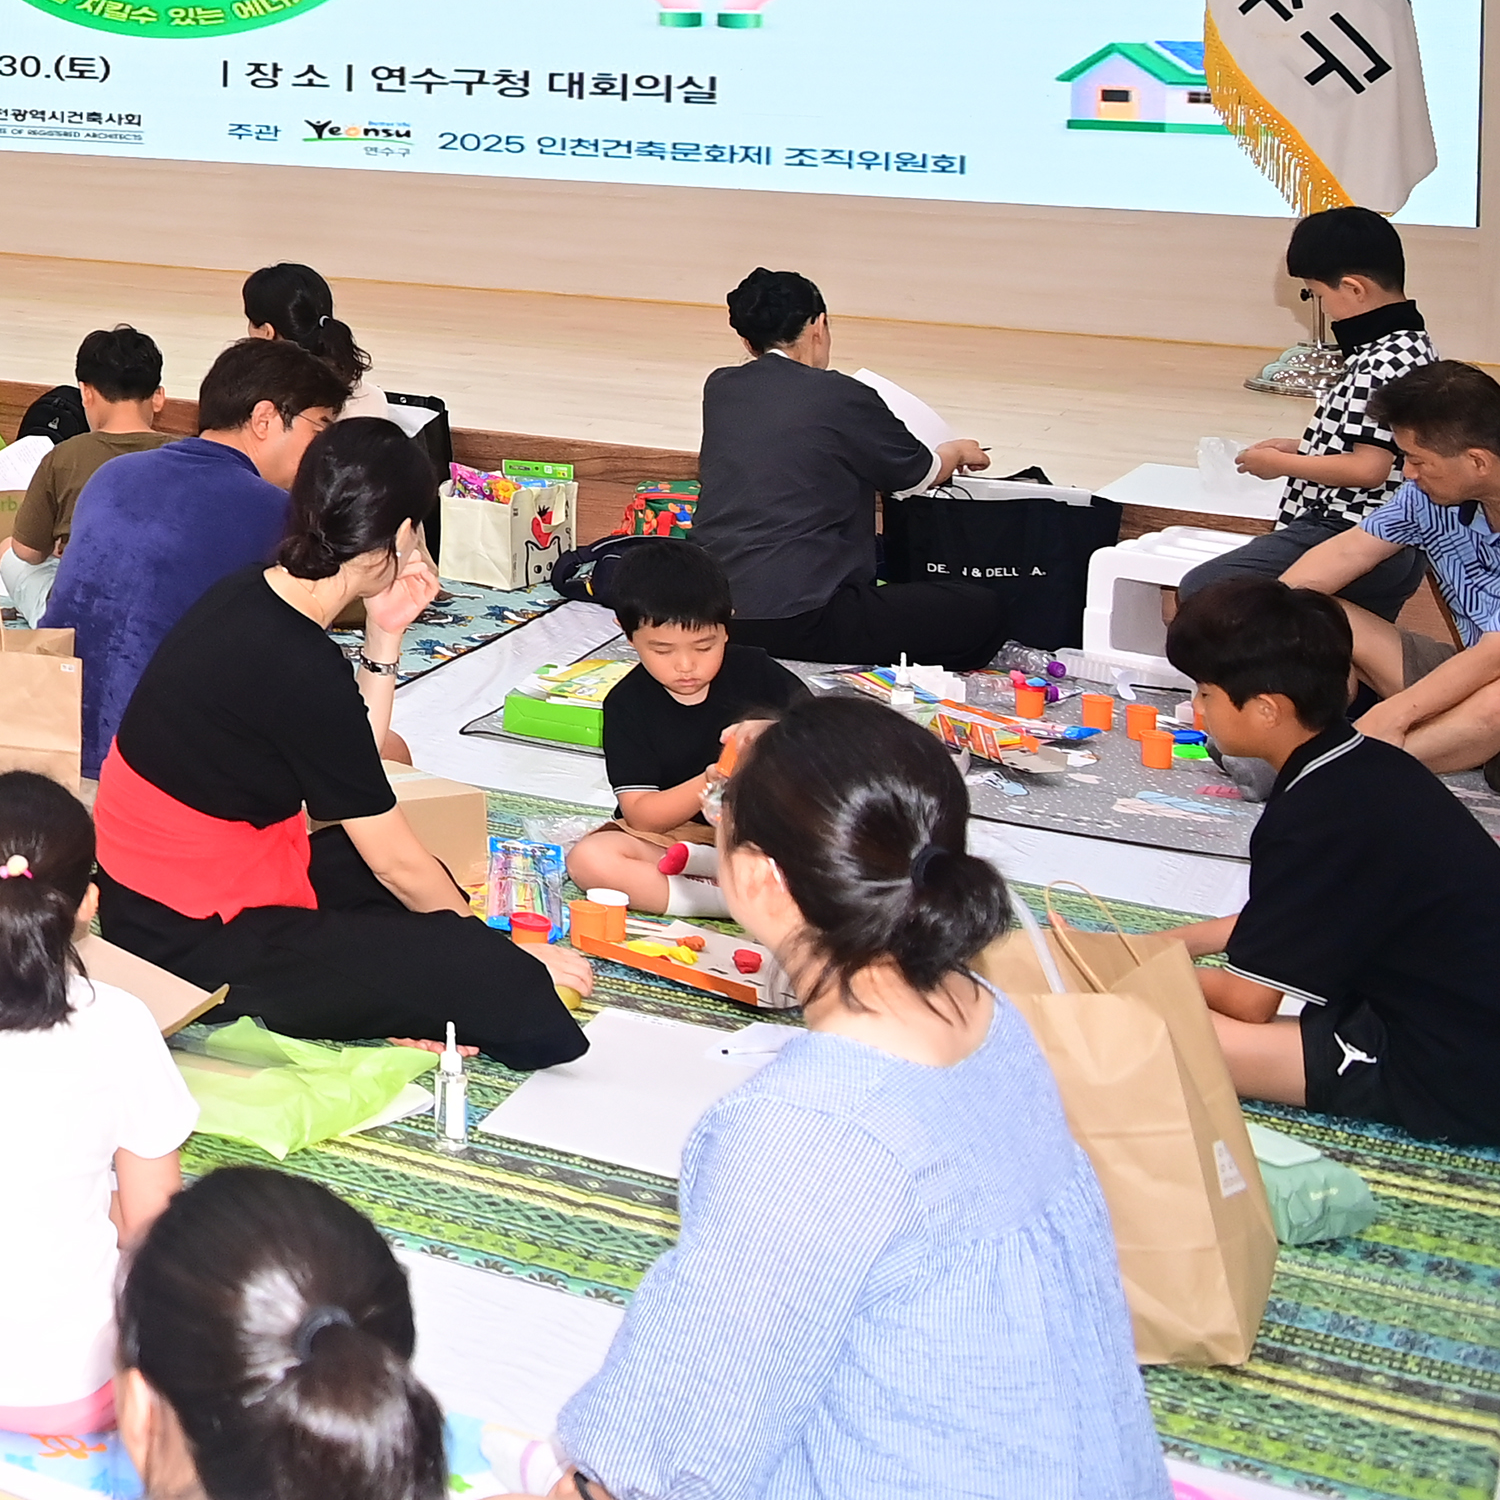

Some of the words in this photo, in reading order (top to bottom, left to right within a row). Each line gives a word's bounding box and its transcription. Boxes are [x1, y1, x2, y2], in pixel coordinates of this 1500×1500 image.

[168, 7, 225, 27] 있는
[370, 63, 532, 99] 연수구청
[547, 70, 719, 106] 대회의실
[227, 122, 282, 142] 주관
[303, 119, 412, 140] Yeonsu
[363, 146, 411, 158] 연수구
[437, 131, 526, 154] 2025
[536, 135, 773, 167] 인천건축문화제
[784, 146, 967, 176] 조직위원회
